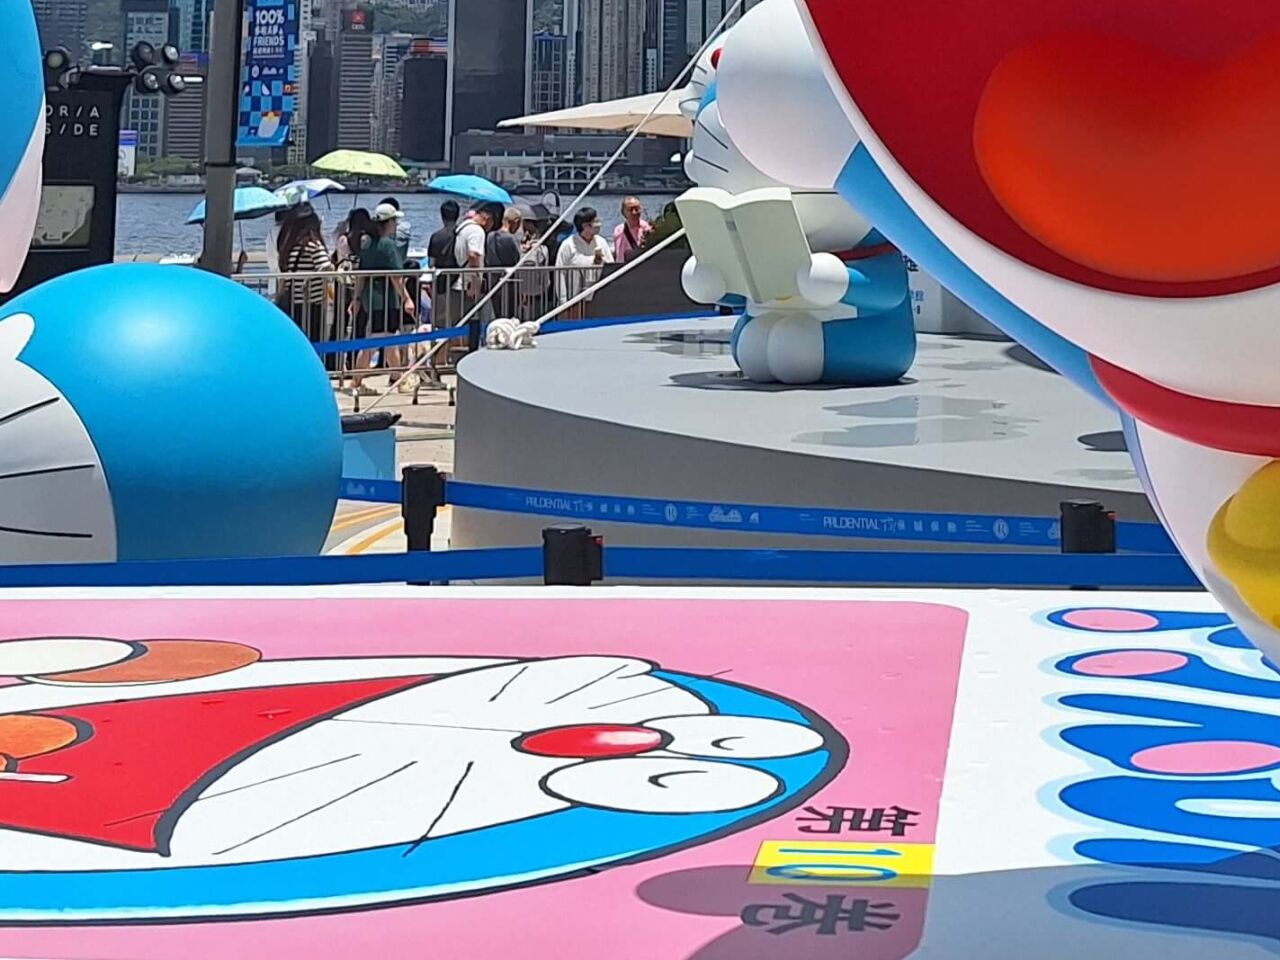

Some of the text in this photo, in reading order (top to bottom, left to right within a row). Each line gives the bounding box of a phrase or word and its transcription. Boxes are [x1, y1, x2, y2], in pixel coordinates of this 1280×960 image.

[255, 9, 285, 25] 100%
[253, 35, 285, 47] FRIENDS
[823, 515, 881, 530] PRUDENTIAL
